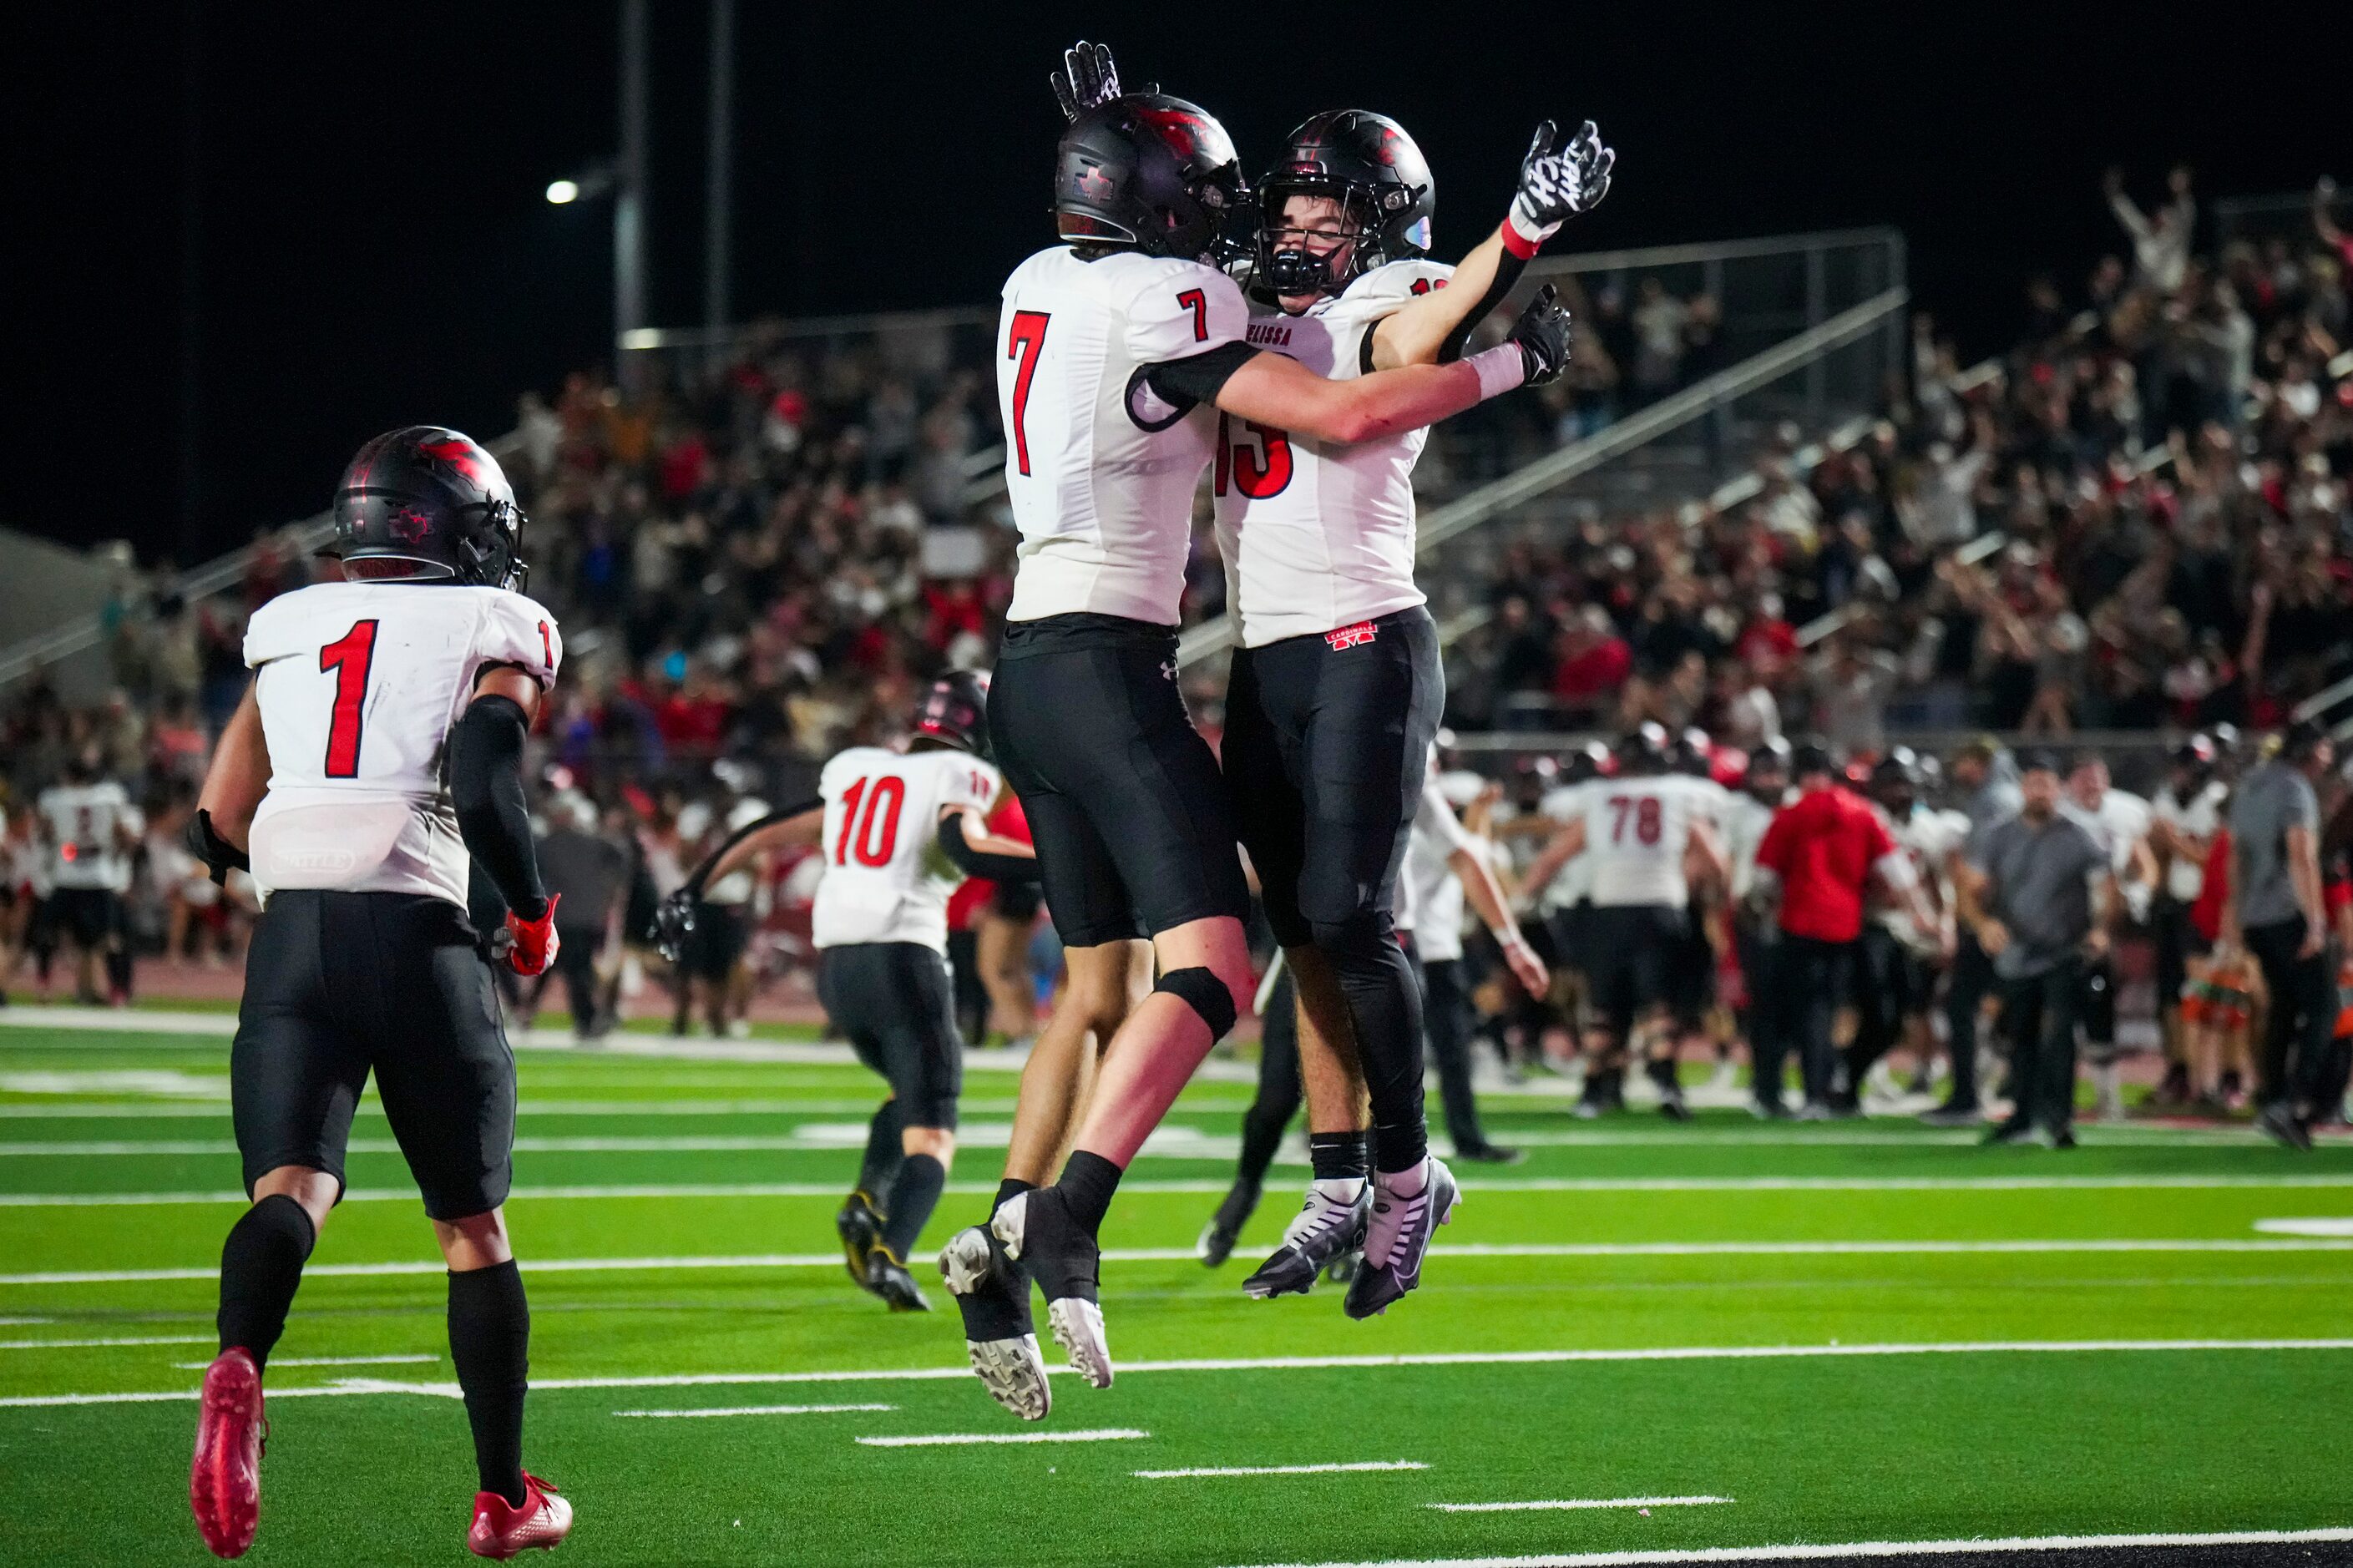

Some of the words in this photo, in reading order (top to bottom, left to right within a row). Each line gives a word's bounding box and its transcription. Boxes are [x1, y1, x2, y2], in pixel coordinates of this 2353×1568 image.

[1175, 288, 1208, 342] 7
[1246, 323, 1293, 346] ELISSA
[1008, 310, 1052, 478] 7
[538, 620, 553, 670] 1
[1330, 625, 1374, 640] CARDINALS
[319, 619, 379, 779] 1
[836, 776, 906, 867] 10
[1607, 795, 1662, 846] 78
